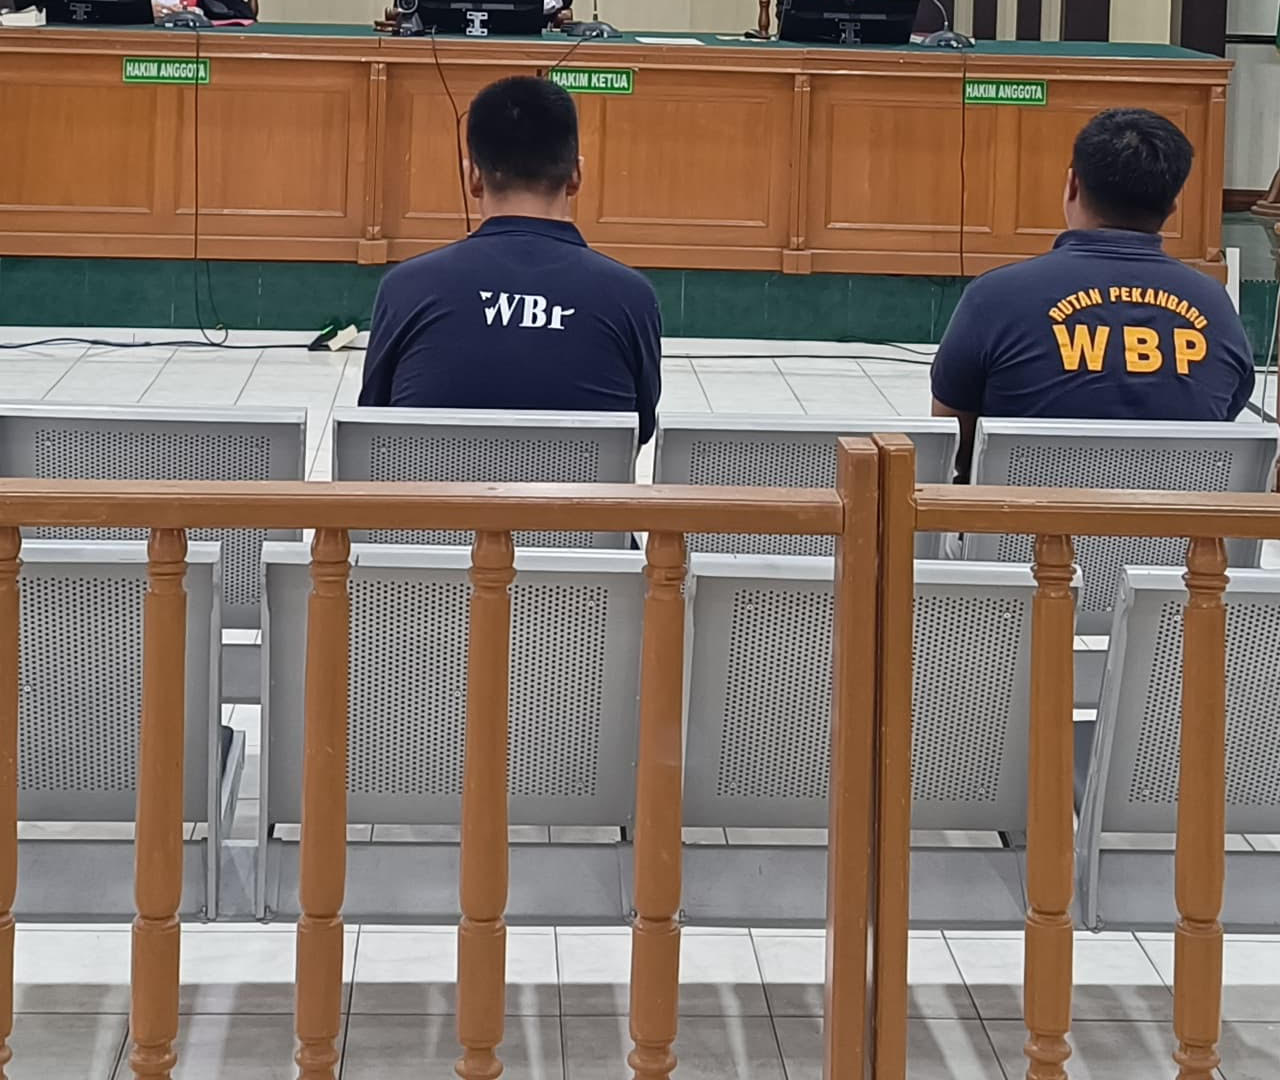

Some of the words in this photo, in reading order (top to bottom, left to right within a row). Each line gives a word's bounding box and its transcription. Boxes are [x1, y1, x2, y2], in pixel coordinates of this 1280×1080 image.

[126, 61, 158, 77] HAKIM
[160, 62, 206, 78] ANGGOTA
[552, 70, 588, 88] HAKIM
[591, 72, 629, 88] KETUA
[966, 82, 996, 98] HAKIM
[998, 84, 1043, 100] ANGGOTA
[1048, 287, 1103, 322] RUTAN
[1109, 286, 1209, 330] PEKANBARU
